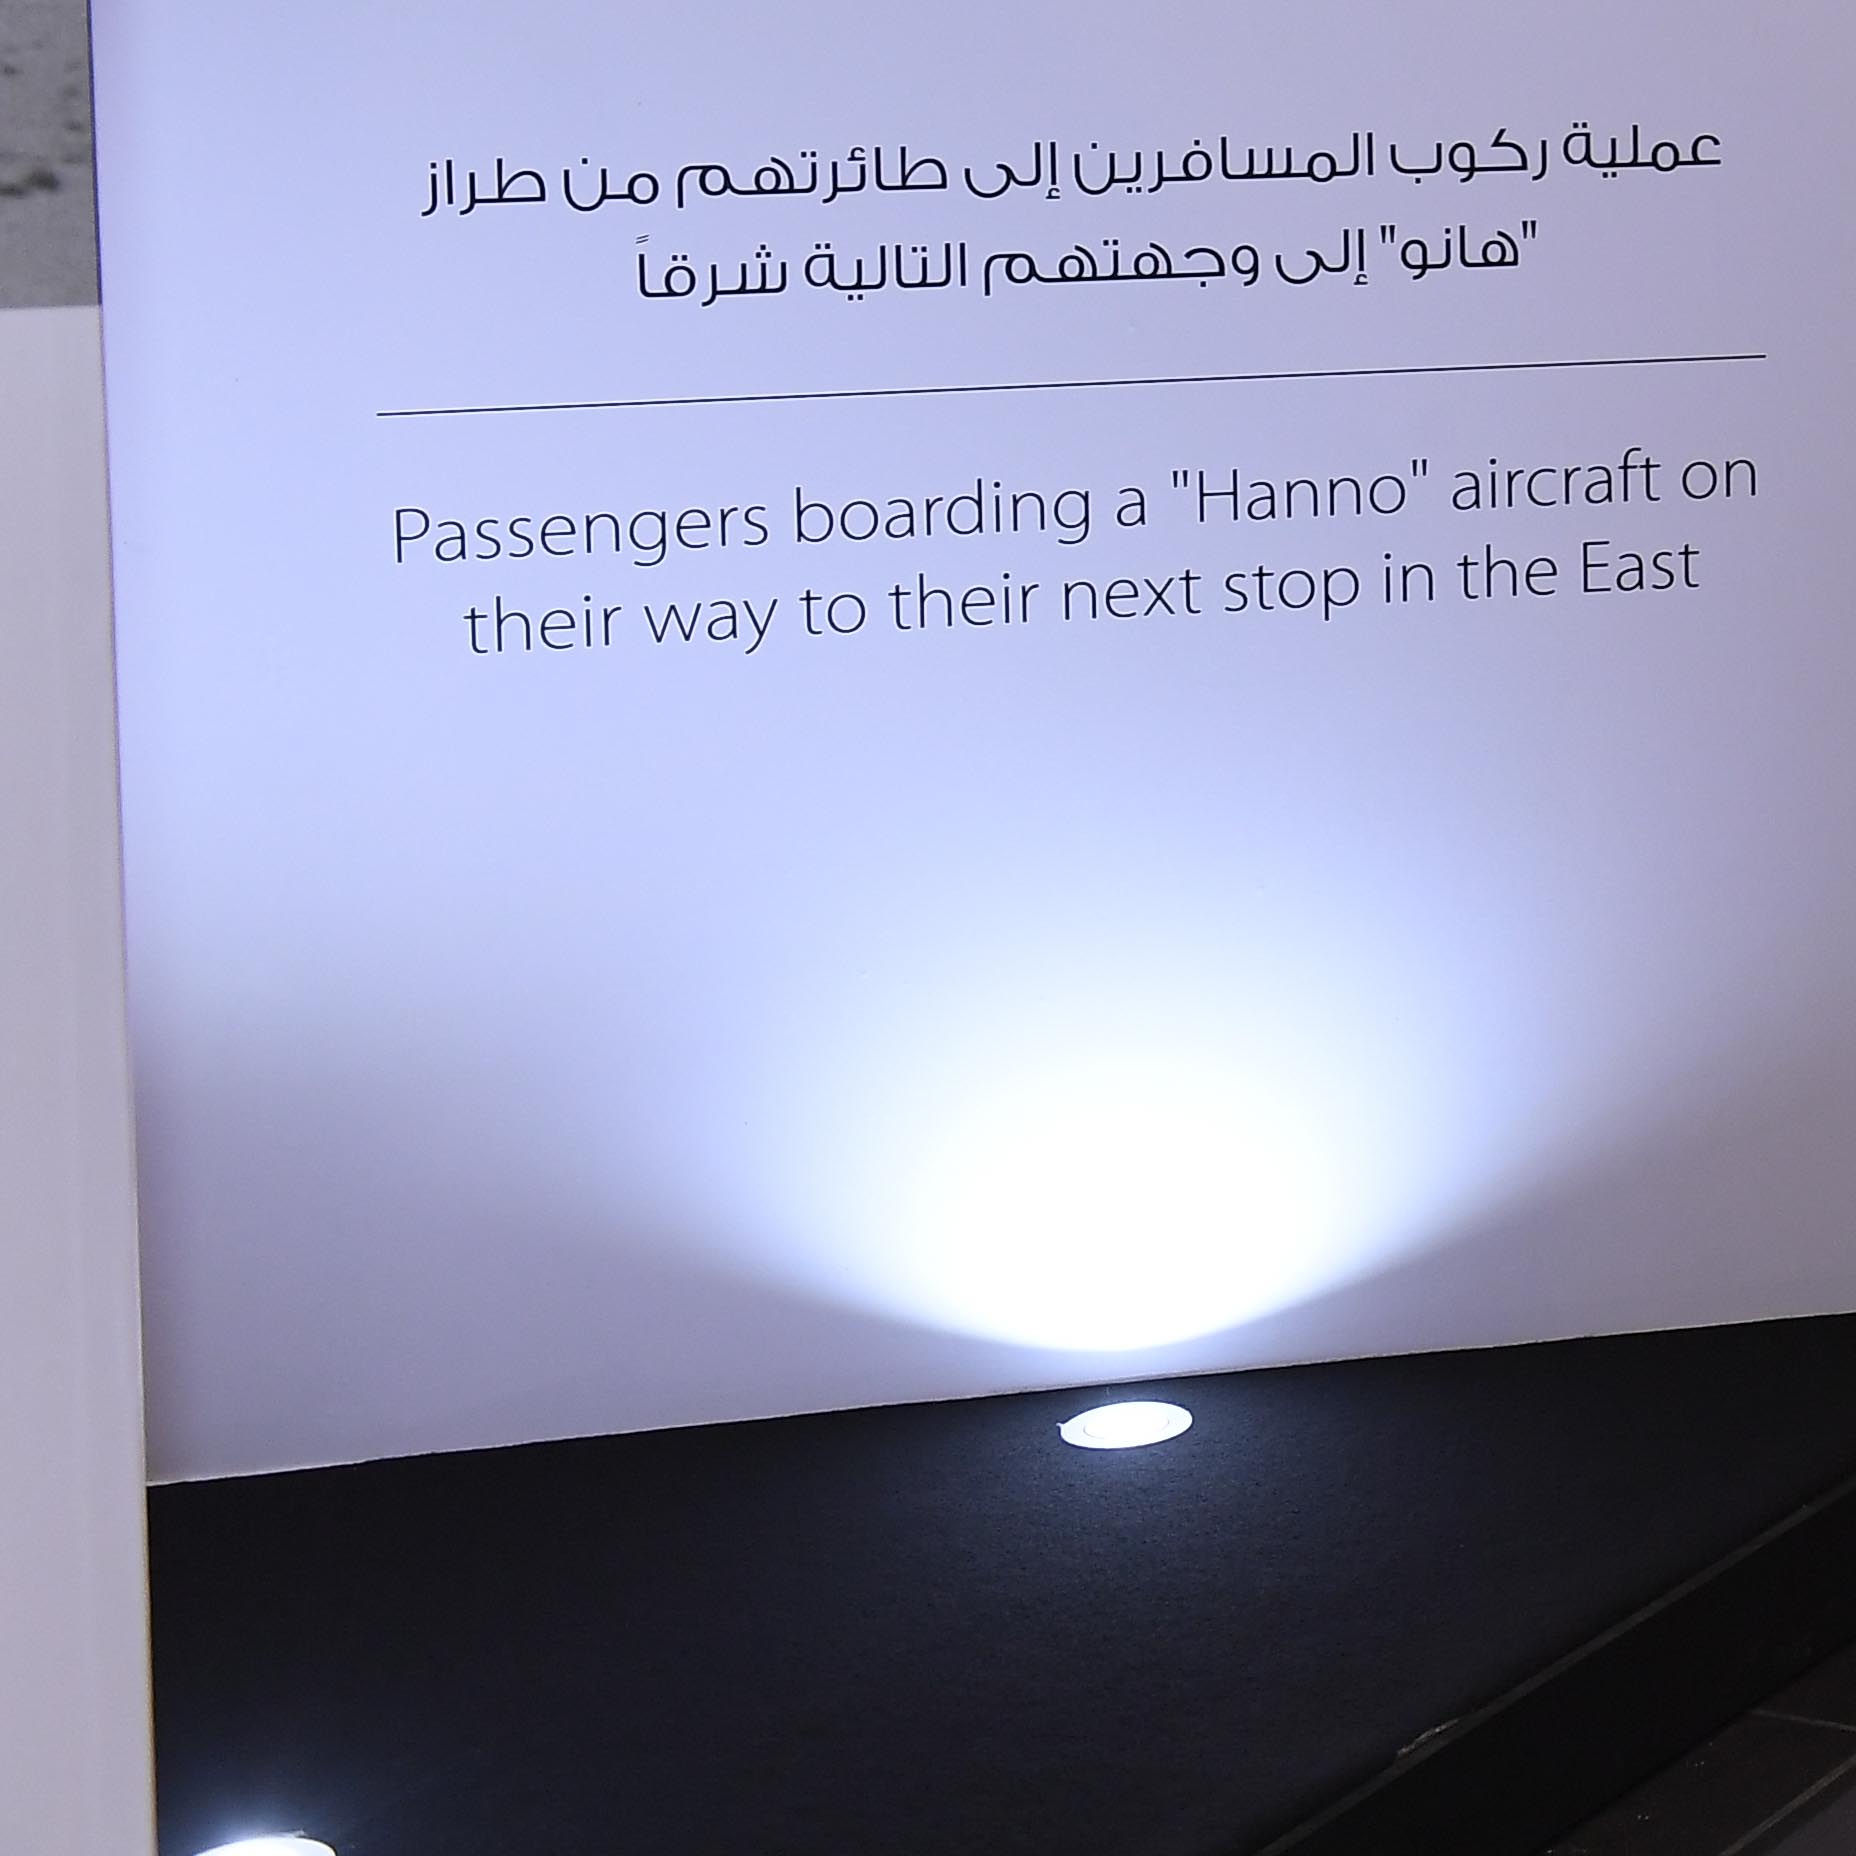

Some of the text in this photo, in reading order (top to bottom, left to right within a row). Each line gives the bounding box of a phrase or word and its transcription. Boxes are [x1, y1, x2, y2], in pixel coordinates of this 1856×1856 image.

[421, 121, 1722, 217] عملية ركوب المسافرين إلى طائرتهم من طراز
[635, 234, 787, 308] شرقاً
[804, 242, 967, 302] التالية
[984, 239, 1259, 297] وجهتهم
[1275, 228, 1369, 286] إلى
[395, 447, 1756, 567] Passengers boarding a "Hanno" aircraft on
[463, 540, 1700, 655] their way to their next stop in the East
